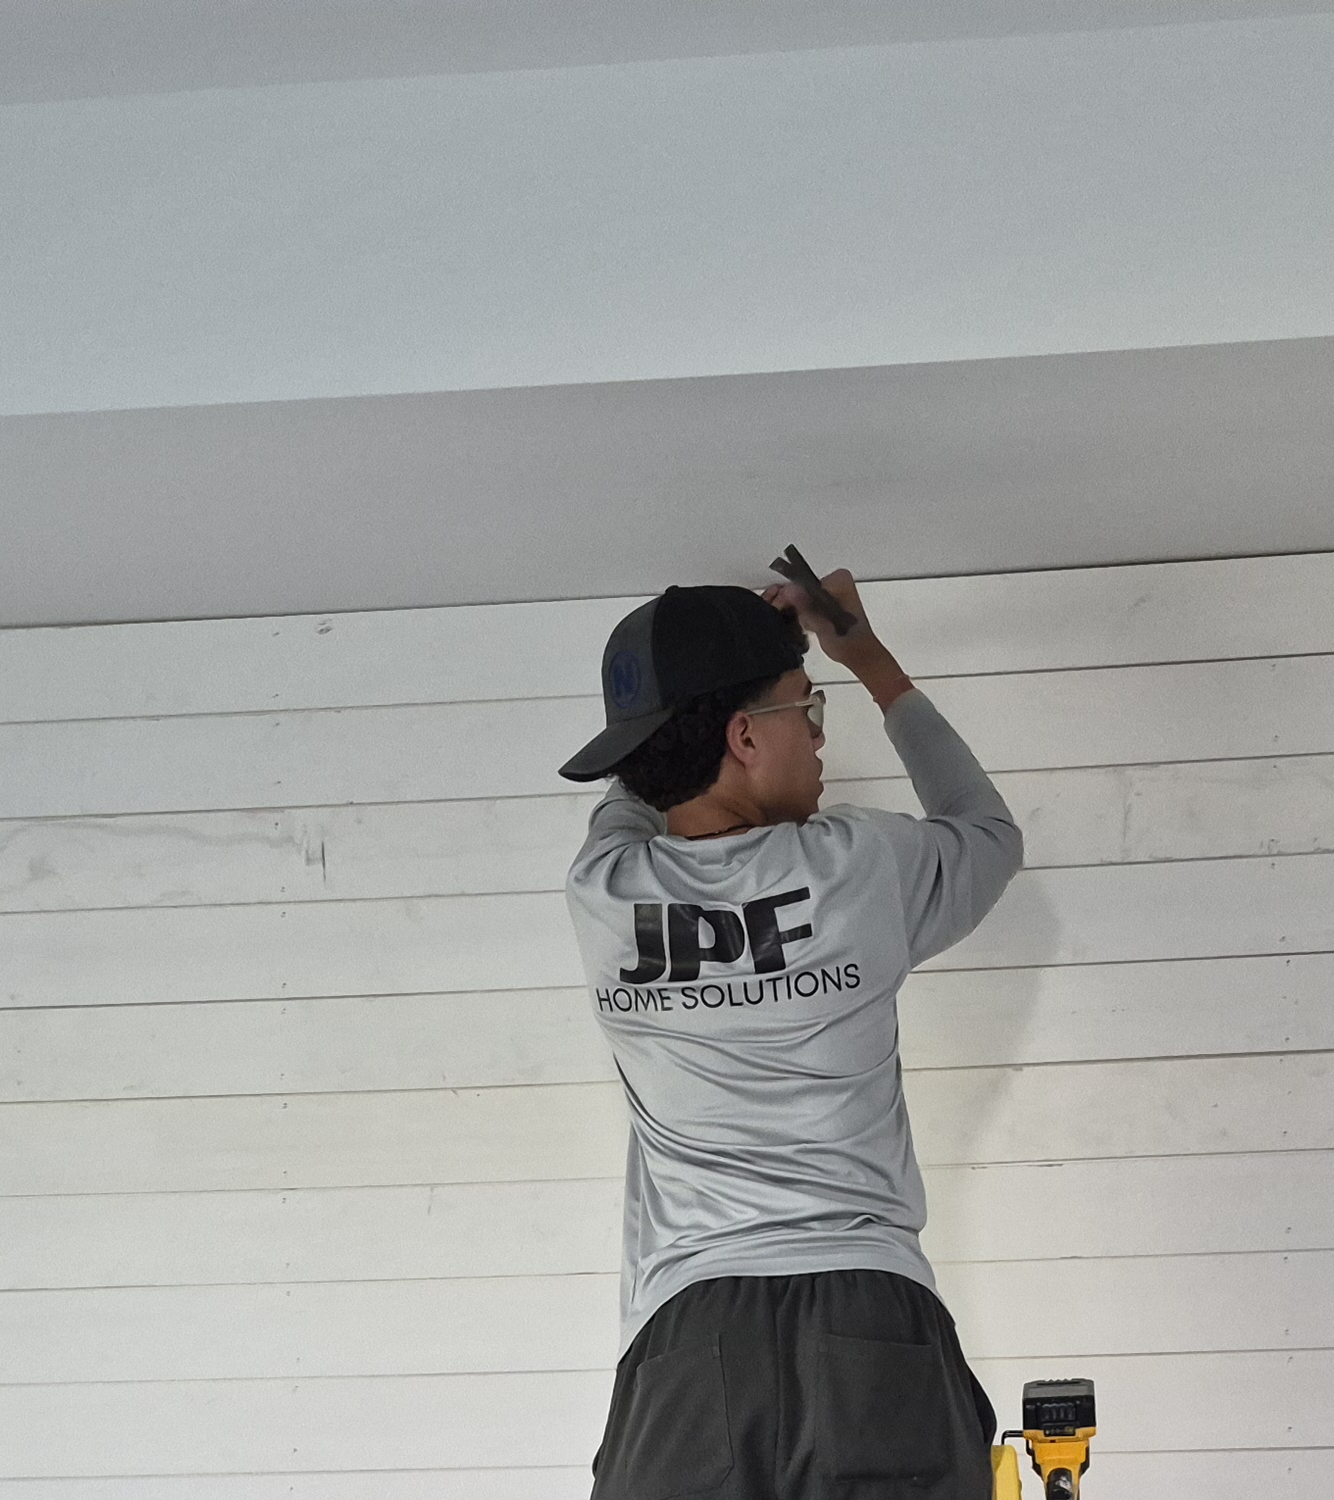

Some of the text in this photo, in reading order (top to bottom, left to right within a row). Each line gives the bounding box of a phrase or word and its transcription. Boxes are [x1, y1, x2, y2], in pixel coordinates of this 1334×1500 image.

[619, 886, 813, 985] JPF
[596, 963, 861, 1012] HOME SOLUTIONS
